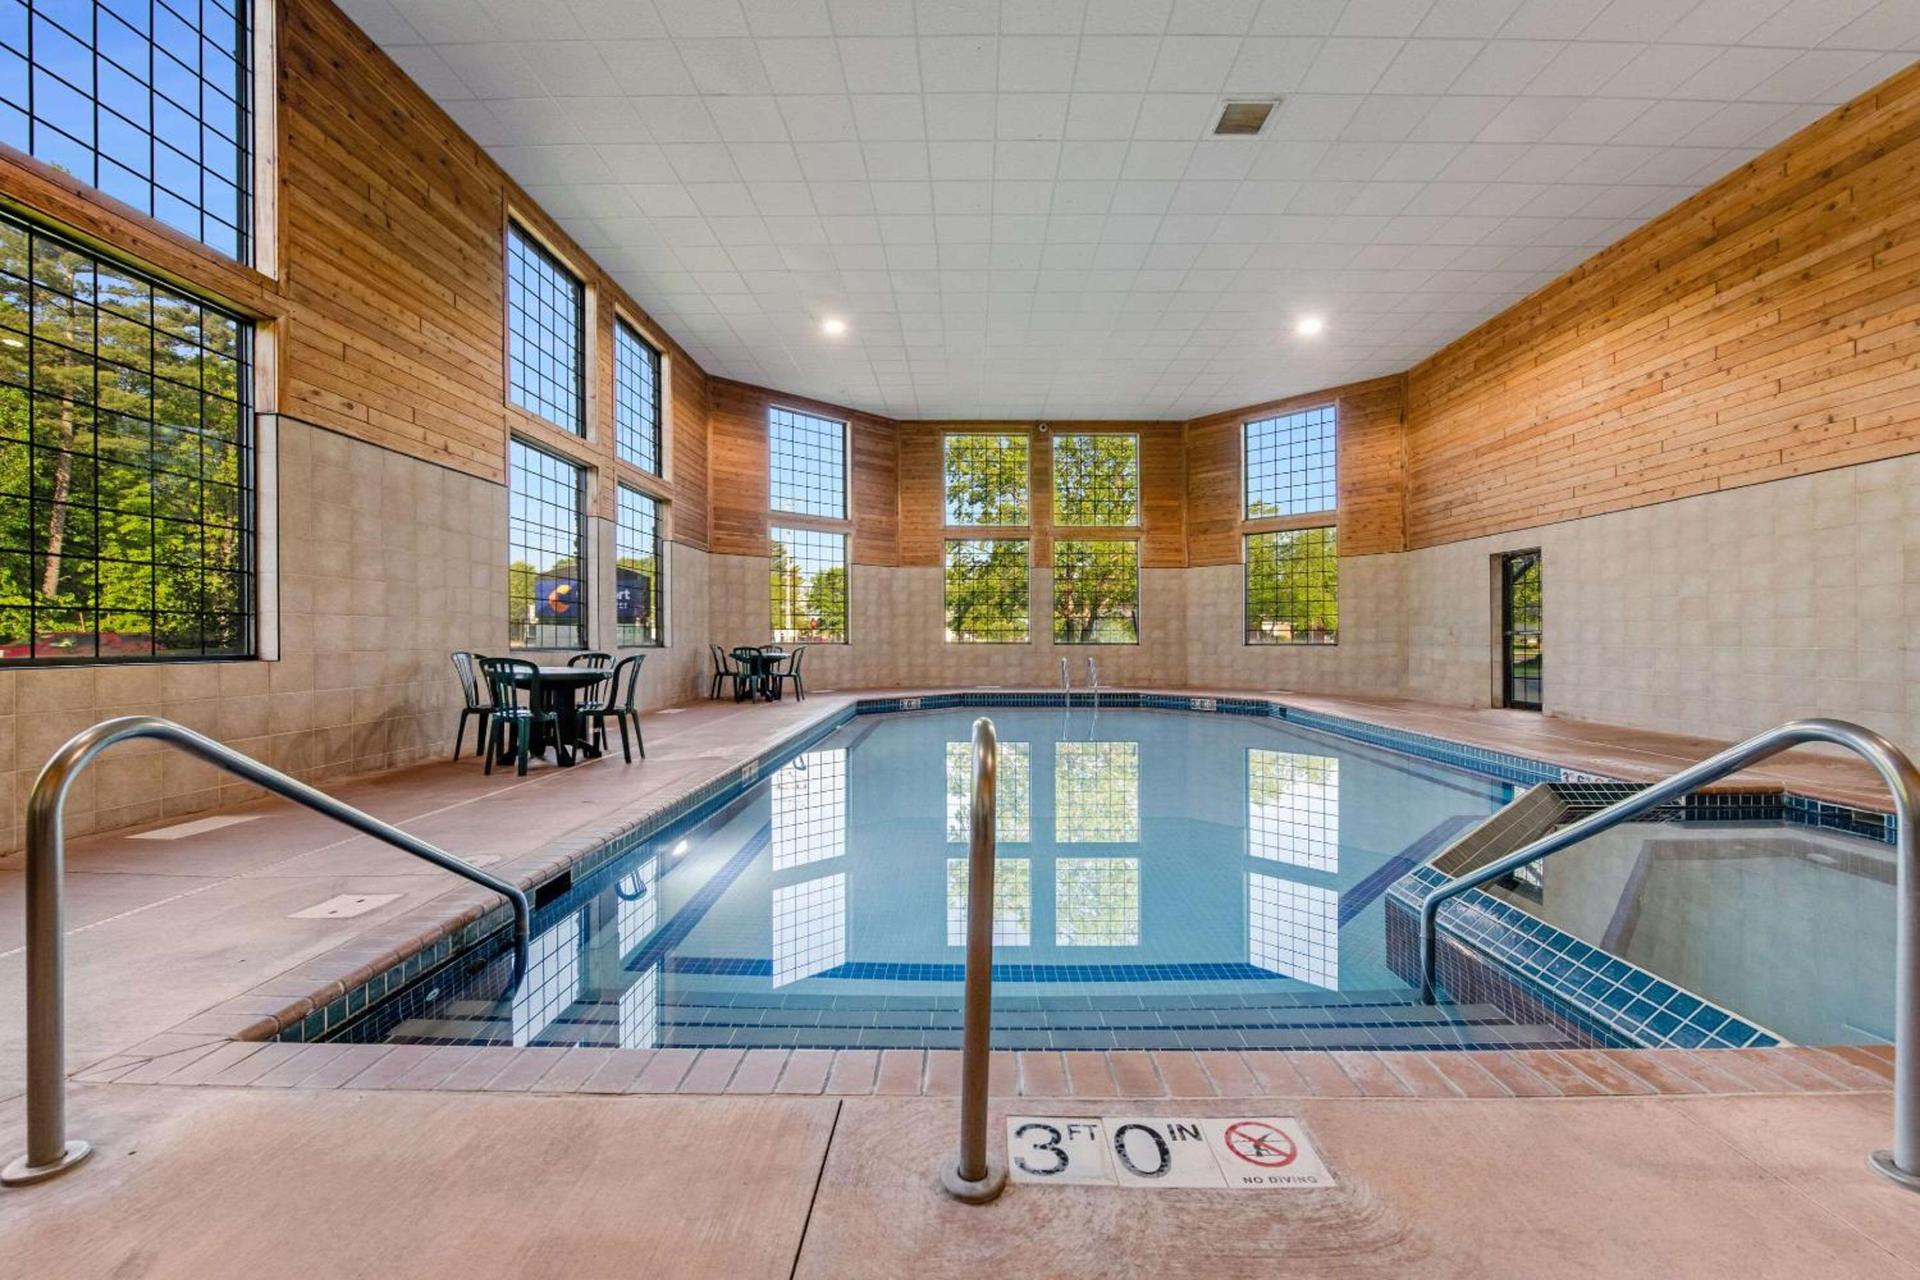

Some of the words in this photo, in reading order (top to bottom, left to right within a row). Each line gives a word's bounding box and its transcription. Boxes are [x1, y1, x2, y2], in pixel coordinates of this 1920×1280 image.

[1014, 1123, 1069, 1176] 3
[1067, 1124, 1097, 1141] FT
[1114, 1123, 1171, 1179] 0
[1167, 1123, 1202, 1141] IN
[1242, 1176, 1264, 1184] NO
[1268, 1175, 1318, 1185] DIVING
